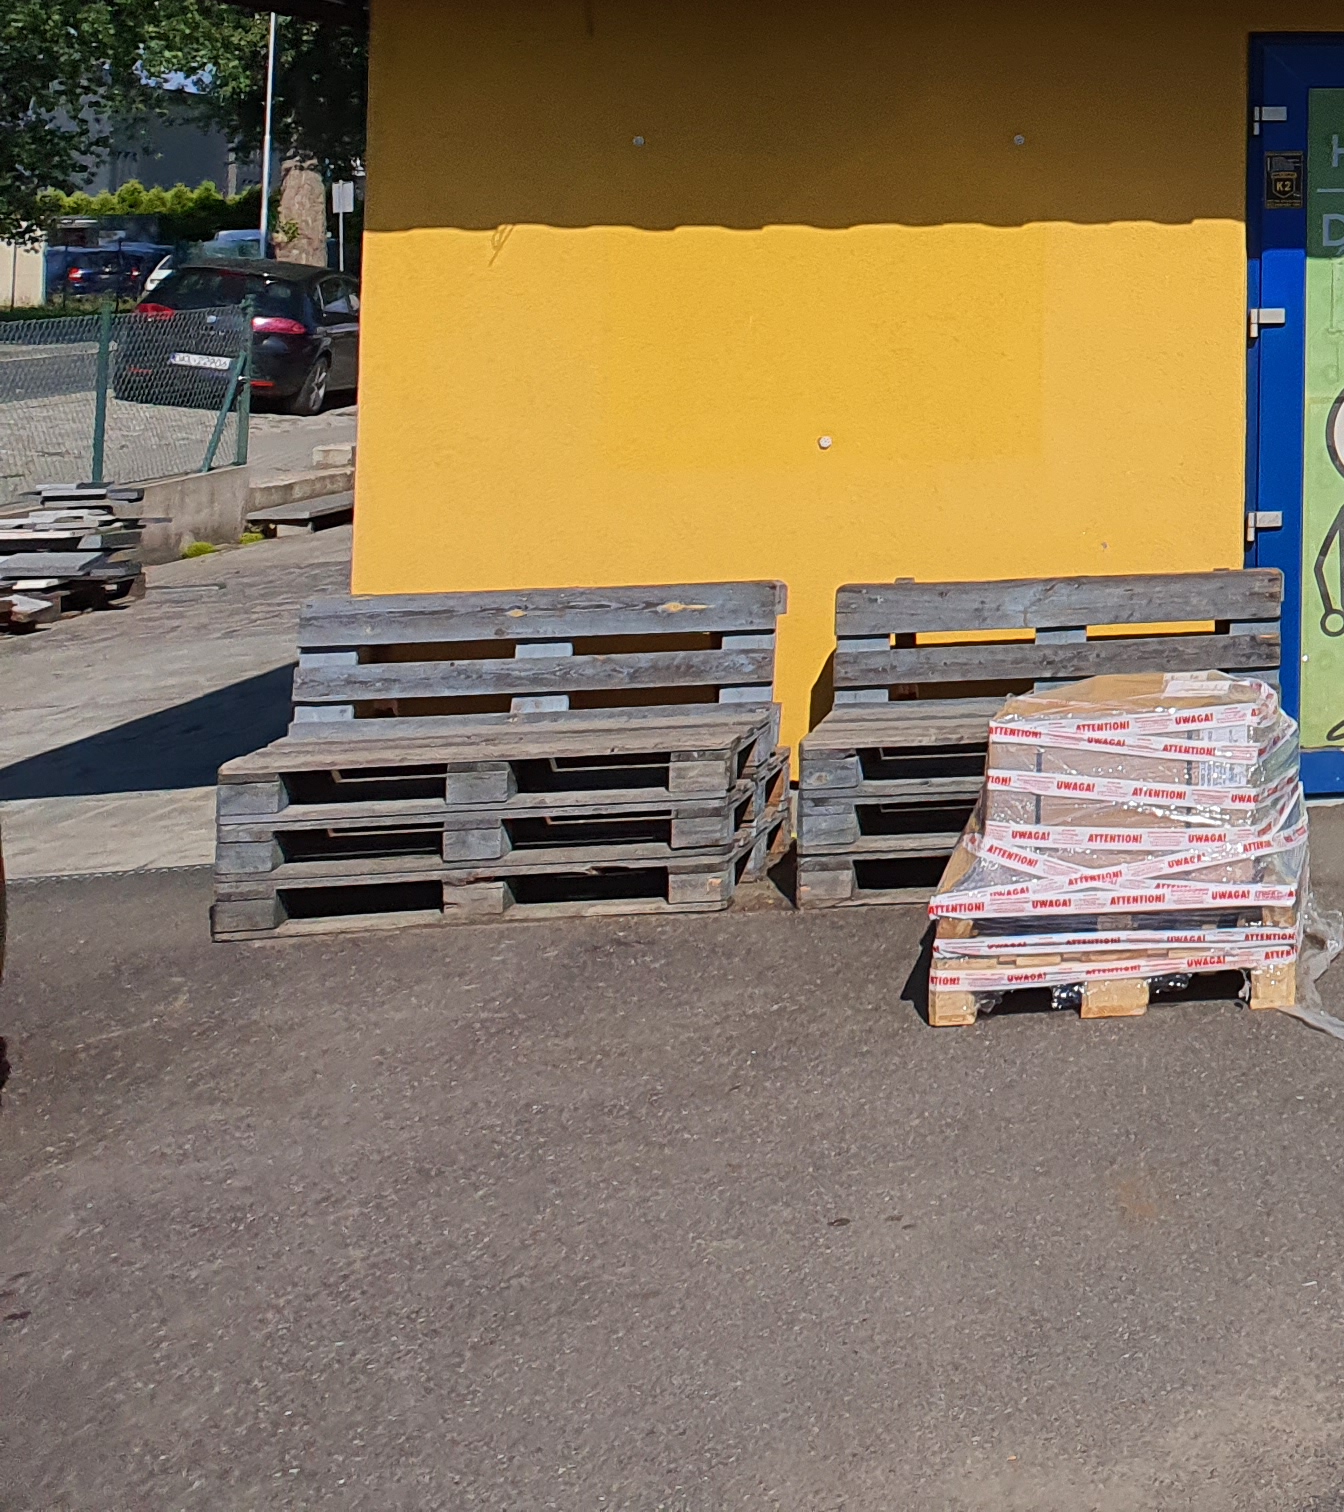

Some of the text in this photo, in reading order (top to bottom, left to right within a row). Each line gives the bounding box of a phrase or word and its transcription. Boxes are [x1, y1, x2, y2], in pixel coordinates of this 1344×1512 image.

[1276, 181, 1292, 191] K2
[1076, 720, 1130, 733] ATTENTION!
[1175, 712, 1214, 725] UWAGA!
[989, 726, 1042, 739] ATTENTION!
[1162, 744, 1216, 756] ATTENTION!
[1056, 780, 1096, 792] UWAGA!
[1132, 787, 1186, 800] ATTENTION!
[1011, 830, 1051, 841] UWAGA!
[1087, 833, 1143, 844] ATTENTION!
[1188, 832, 1227, 843] UWAGA!
[986, 843, 1039, 868] ATTENTION!
[928, 901, 985, 915] ATTENTION!
[1032, 898, 1072, 909] UWAGA!
[1110, 893, 1166, 906] ATTENTION!
[1211, 890, 1250, 900] UWAGA!
[1187, 956, 1226, 967] UWAGA!
